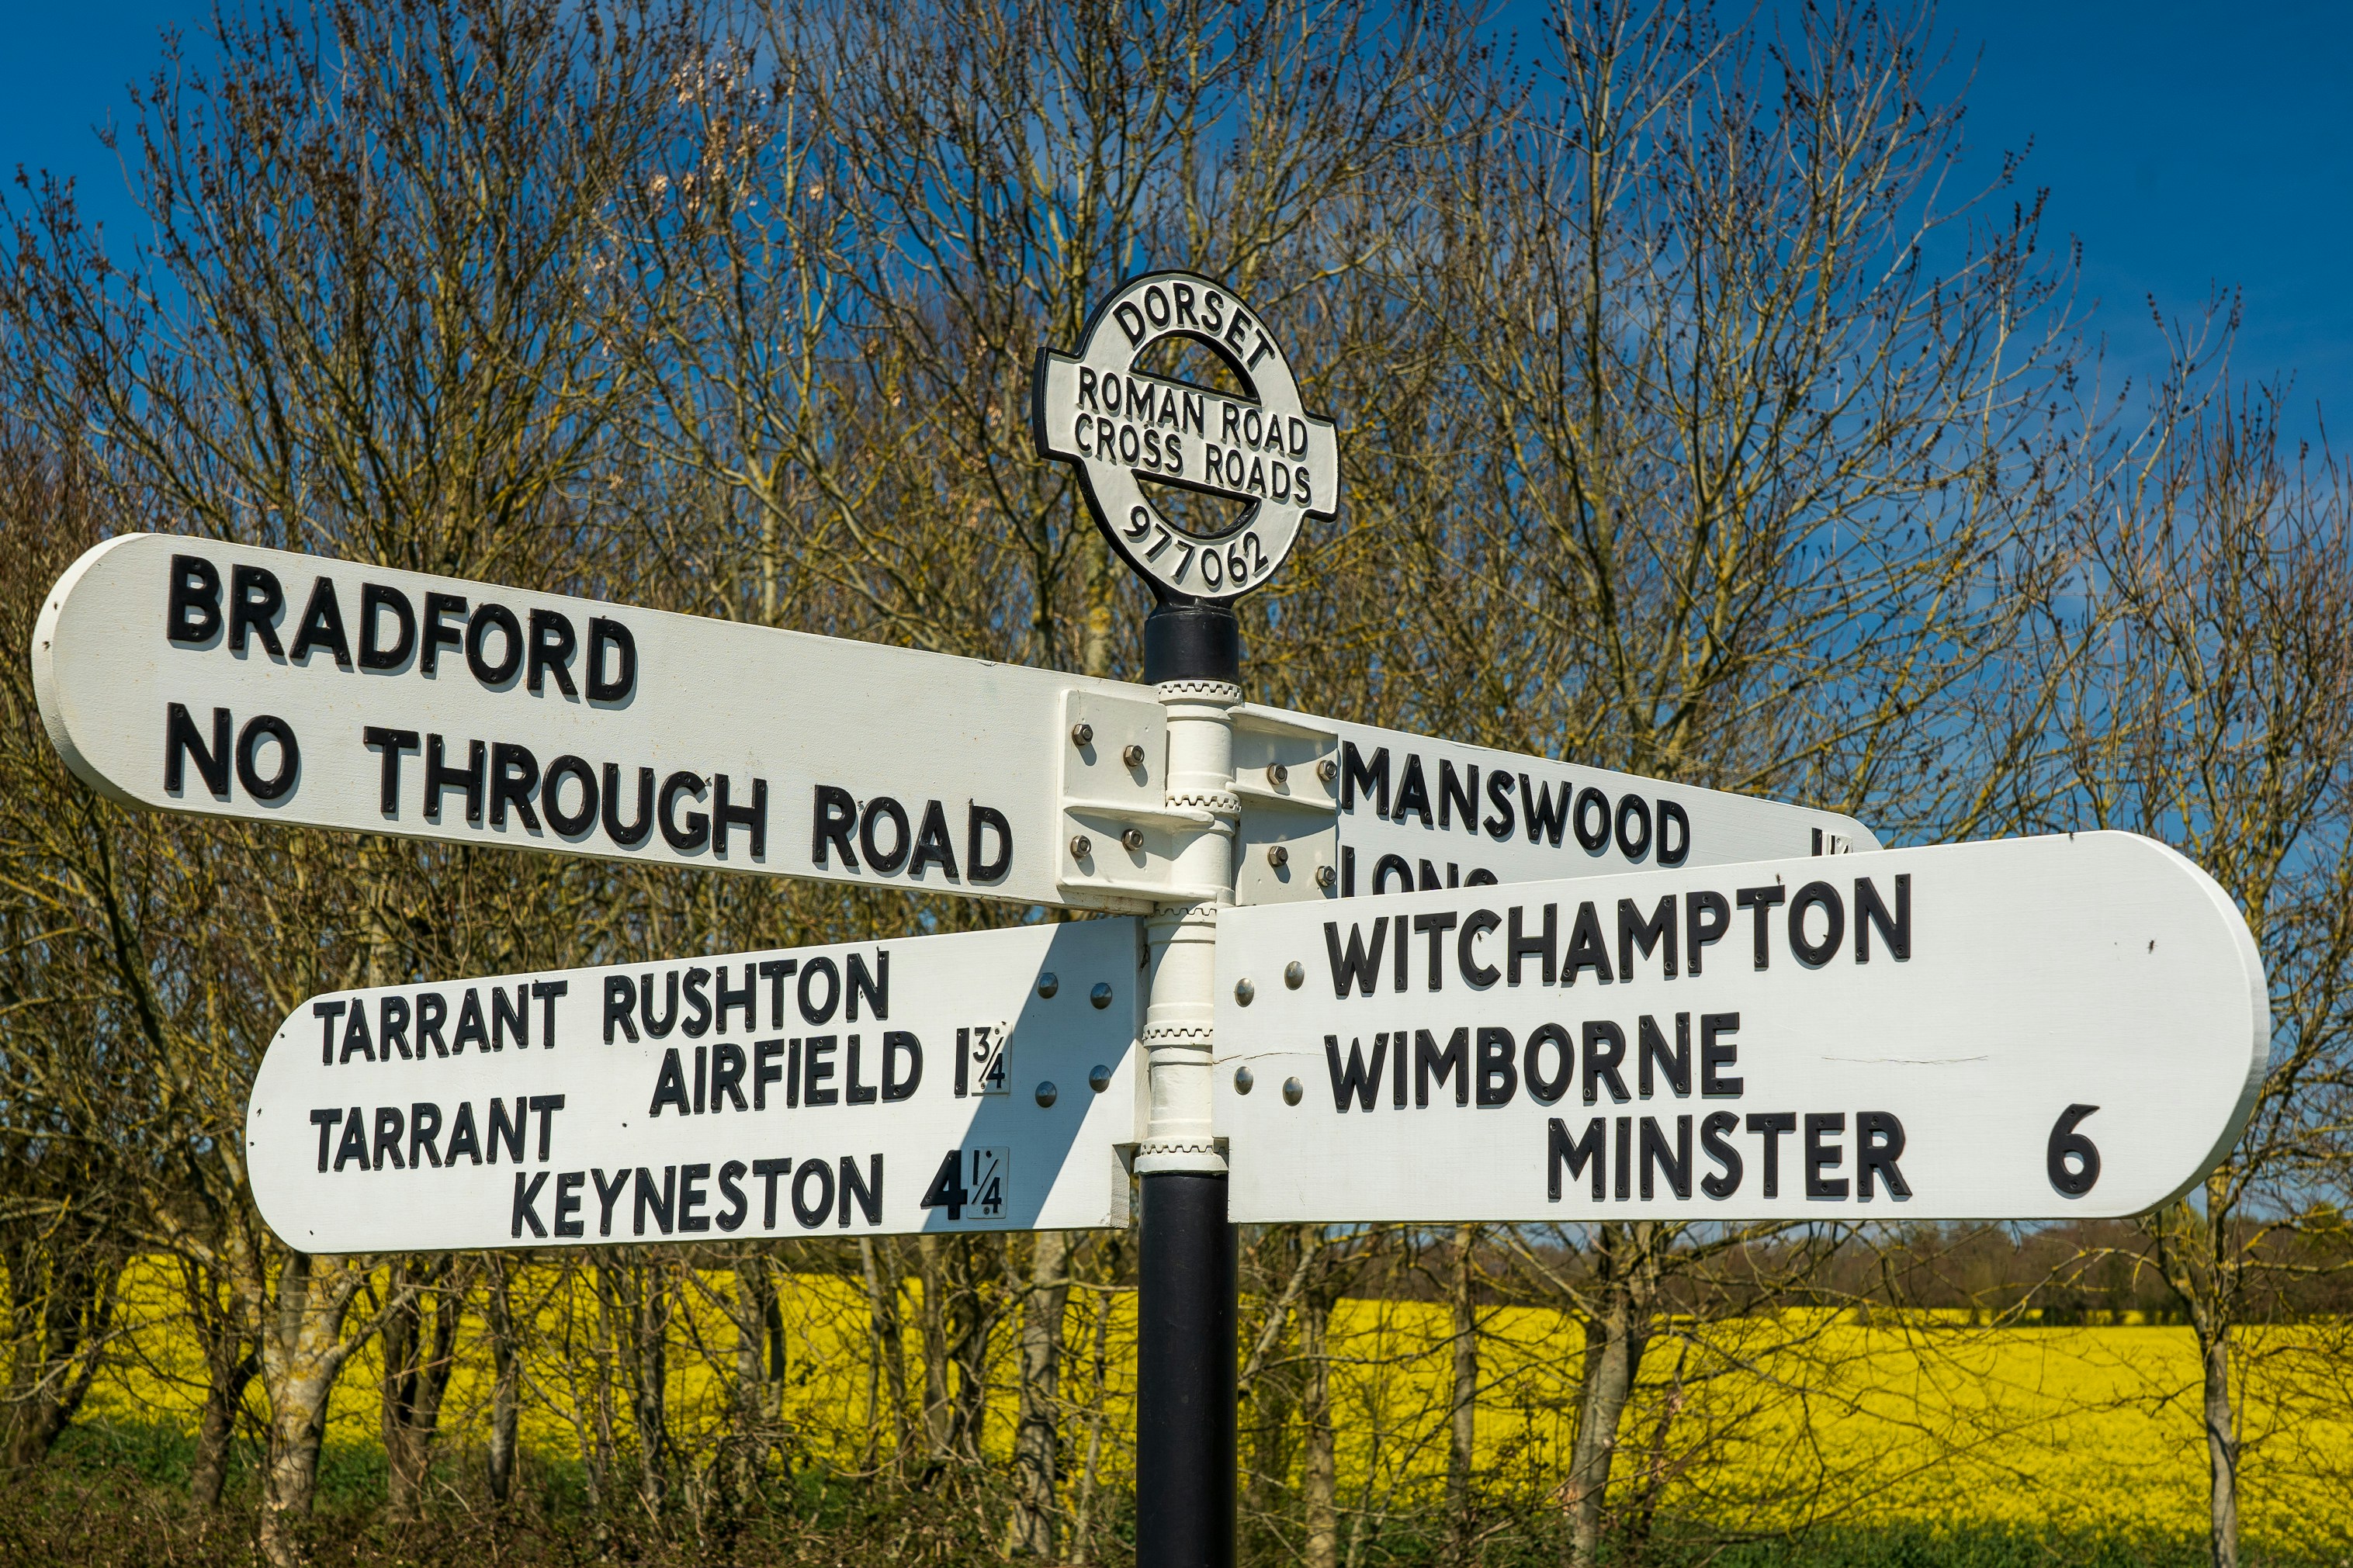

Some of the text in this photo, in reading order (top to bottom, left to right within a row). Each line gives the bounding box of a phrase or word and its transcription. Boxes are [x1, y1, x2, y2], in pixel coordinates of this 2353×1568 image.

[1113, 282, 1276, 372] DORSET
[1074, 413, 1312, 508] CROSS ROADS
[1078, 365, 1308, 459] ROMAN ROAD
[1122, 505, 1270, 587] 977062
[167, 554, 638, 712] BRADFORD
[165, 702, 1014, 887] NO THROUGH ROAD
[1342, 740, 1690, 869] MANSWOOD
[1324, 874, 1911, 1001] WITCHAMPTON
[313, 947, 890, 1067] TARRANT RUSHTON
[649, 1031, 924, 1119] AIRFIELD
[1324, 1012, 1745, 1115] WIMBORNE
[310, 1095, 566, 1174] TARRANT
[1548, 1102, 2102, 1205] MINSTER 6
[511, 1154, 884, 1239] KEYNESTON
